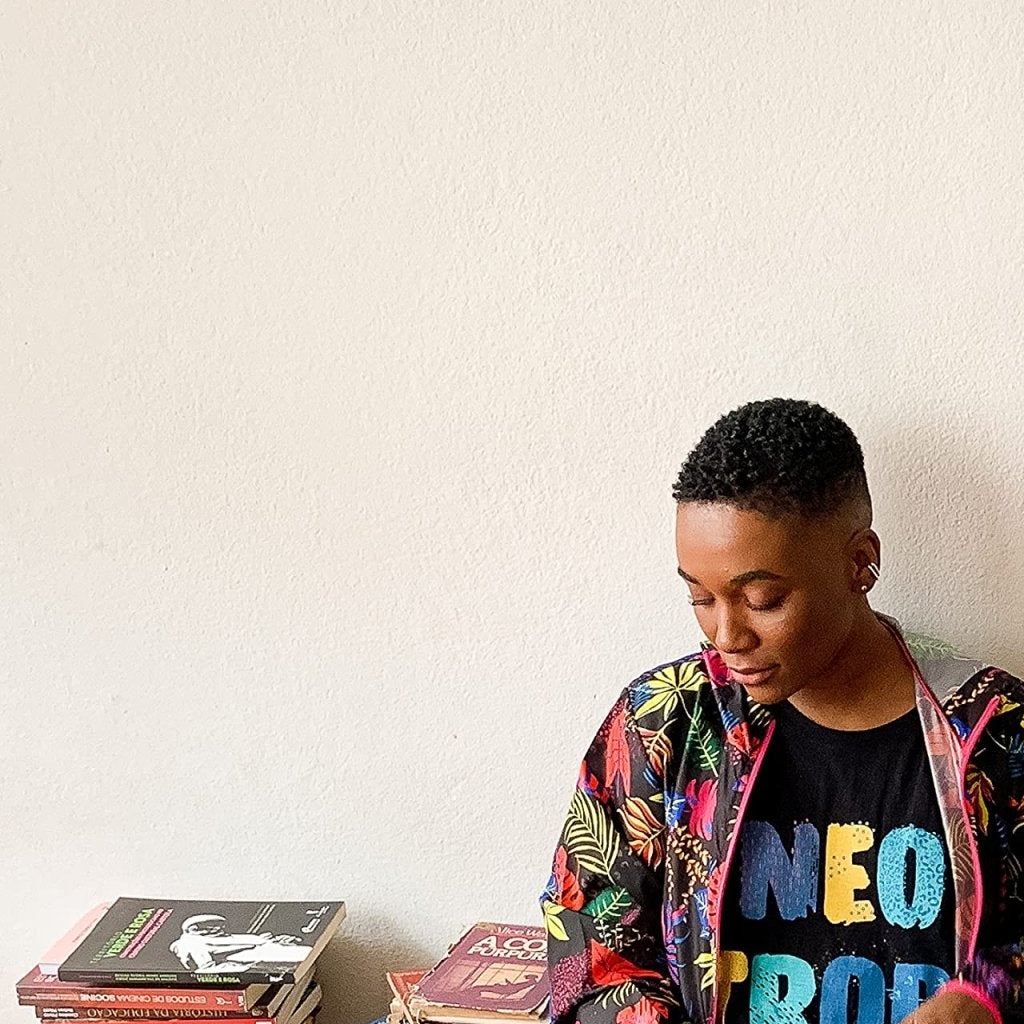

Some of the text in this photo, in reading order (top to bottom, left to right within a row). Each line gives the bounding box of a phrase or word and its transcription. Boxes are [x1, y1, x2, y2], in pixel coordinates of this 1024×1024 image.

[739, 820, 946, 930] NEO
[475, 936, 548, 952] A CO
[80, 993, 115, 1002] SOCINE
[117, 994, 151, 1003] CINEMA
[152, 994, 164, 1003] DE
[165, 994, 206, 1004] ESTUDOS
[87, 1008, 151, 1018] EDUCAÇÃO
[153, 1008, 171, 1018] DA
[174, 1009, 227, 1018] HISTÓRIA
